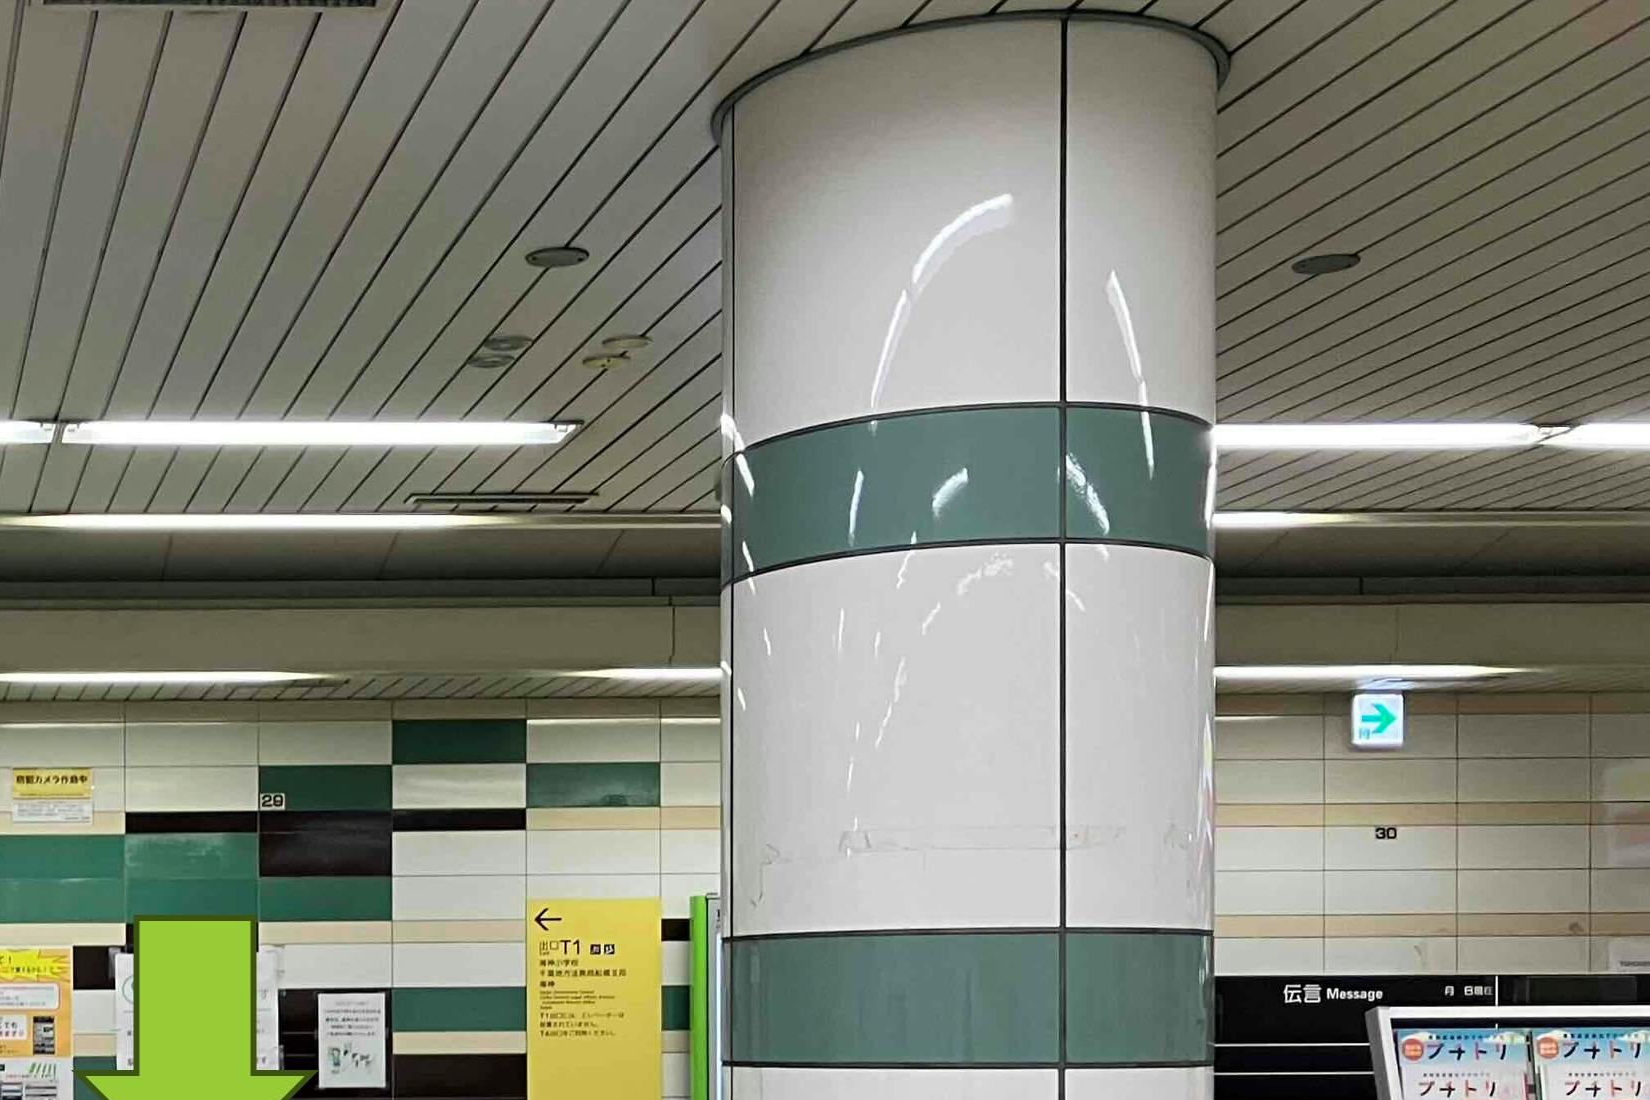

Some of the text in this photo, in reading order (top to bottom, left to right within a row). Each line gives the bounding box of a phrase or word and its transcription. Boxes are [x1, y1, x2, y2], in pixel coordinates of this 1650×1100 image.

[261, 794, 284, 808] 29
[1375, 827, 1397, 840] 30
[1283, 984, 1383, 1003] 伝言 Message
